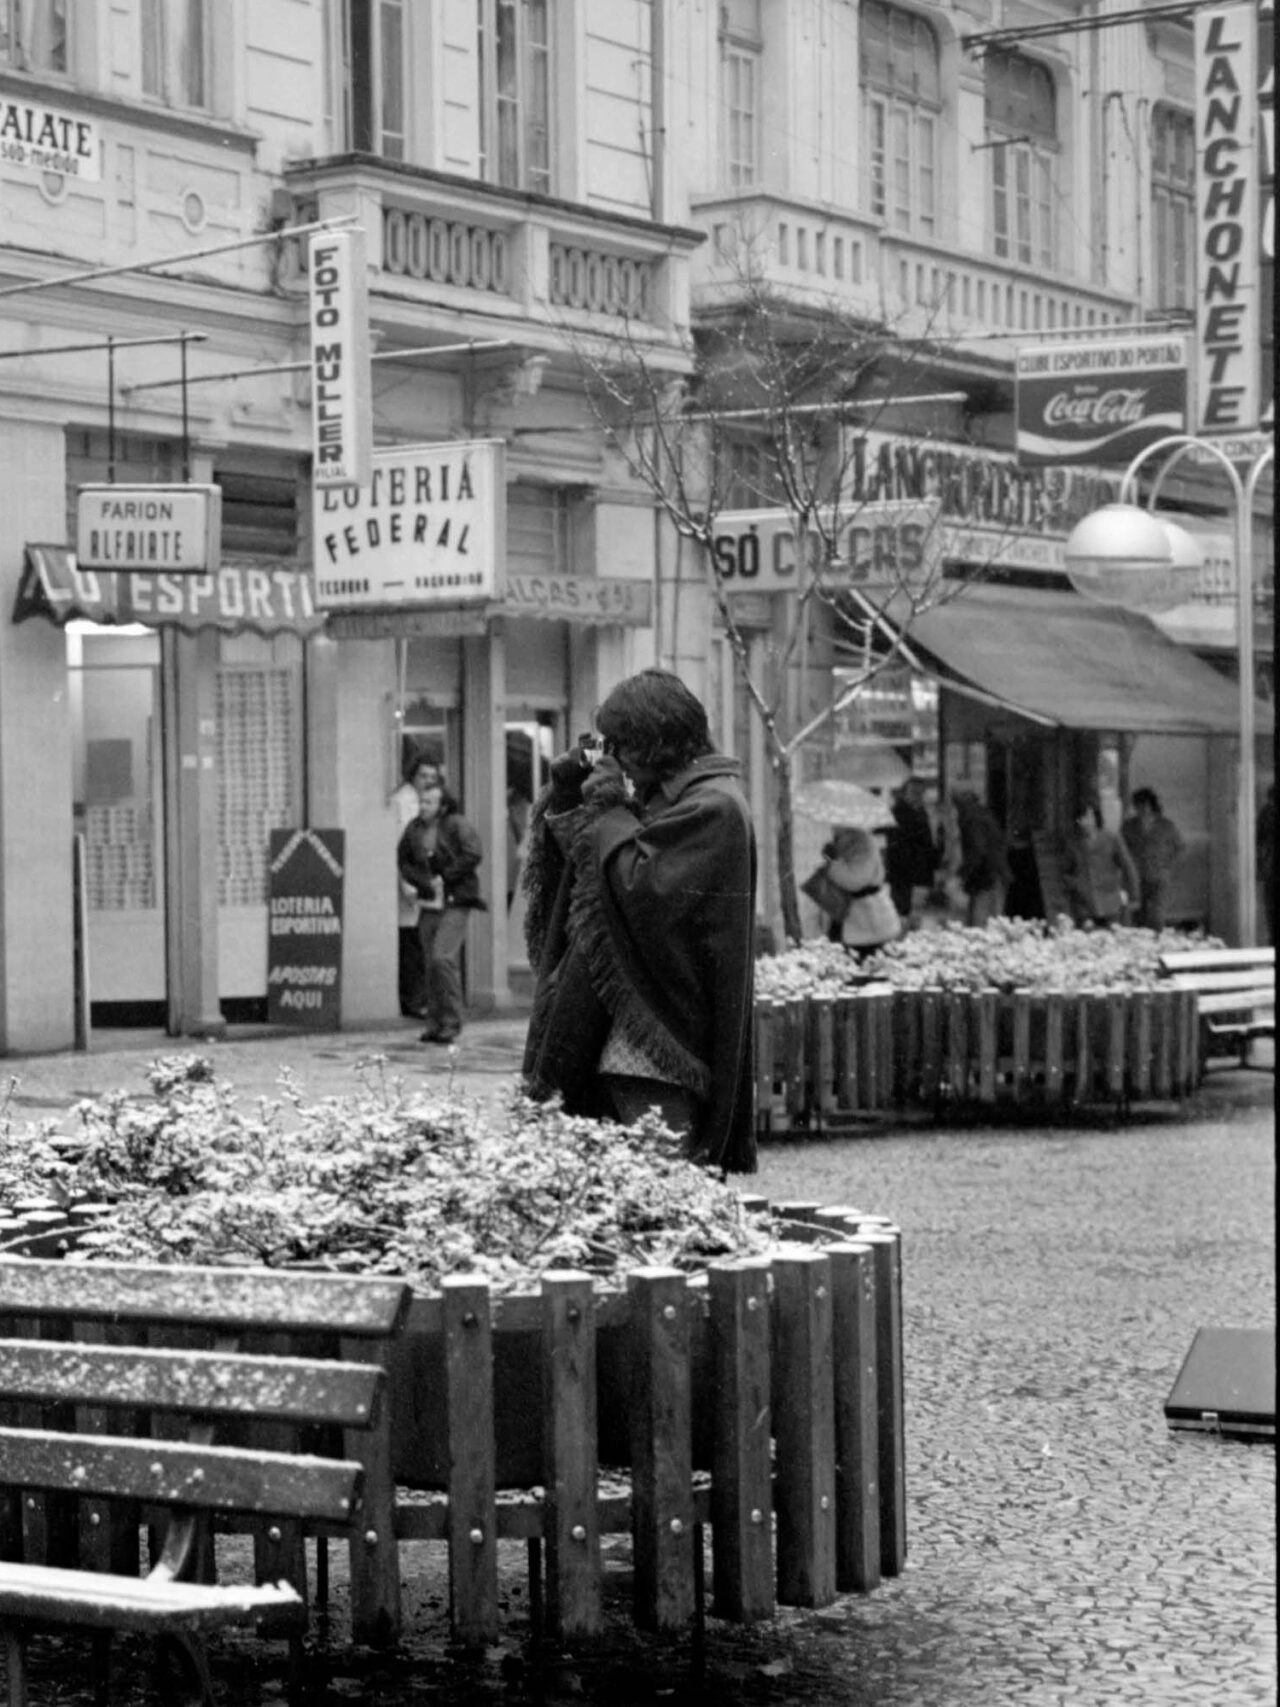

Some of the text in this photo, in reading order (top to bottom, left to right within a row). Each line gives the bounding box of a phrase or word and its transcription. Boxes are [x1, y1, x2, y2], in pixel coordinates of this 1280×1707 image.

[1204, 16, 1246, 427] LANCHONETE
[314, 246, 344, 464] FOTO MULLER
[1054, 350, 1117, 371] ESPORTIVO
[1043, 387, 1151, 427] Coca-Cola
[322, 459, 475, 512] LOTERIA
[101, 501, 173, 520] FARION
[90, 529, 182, 561] ALFAIATE
[324, 513, 470, 564] FEDERAL
[715, 523, 759, 579] SÓ
[271, 896, 335, 915] LOTERIA
[271, 916, 341, 935] ESPORTIVA
[281, 989, 323, 1011] AQUI
